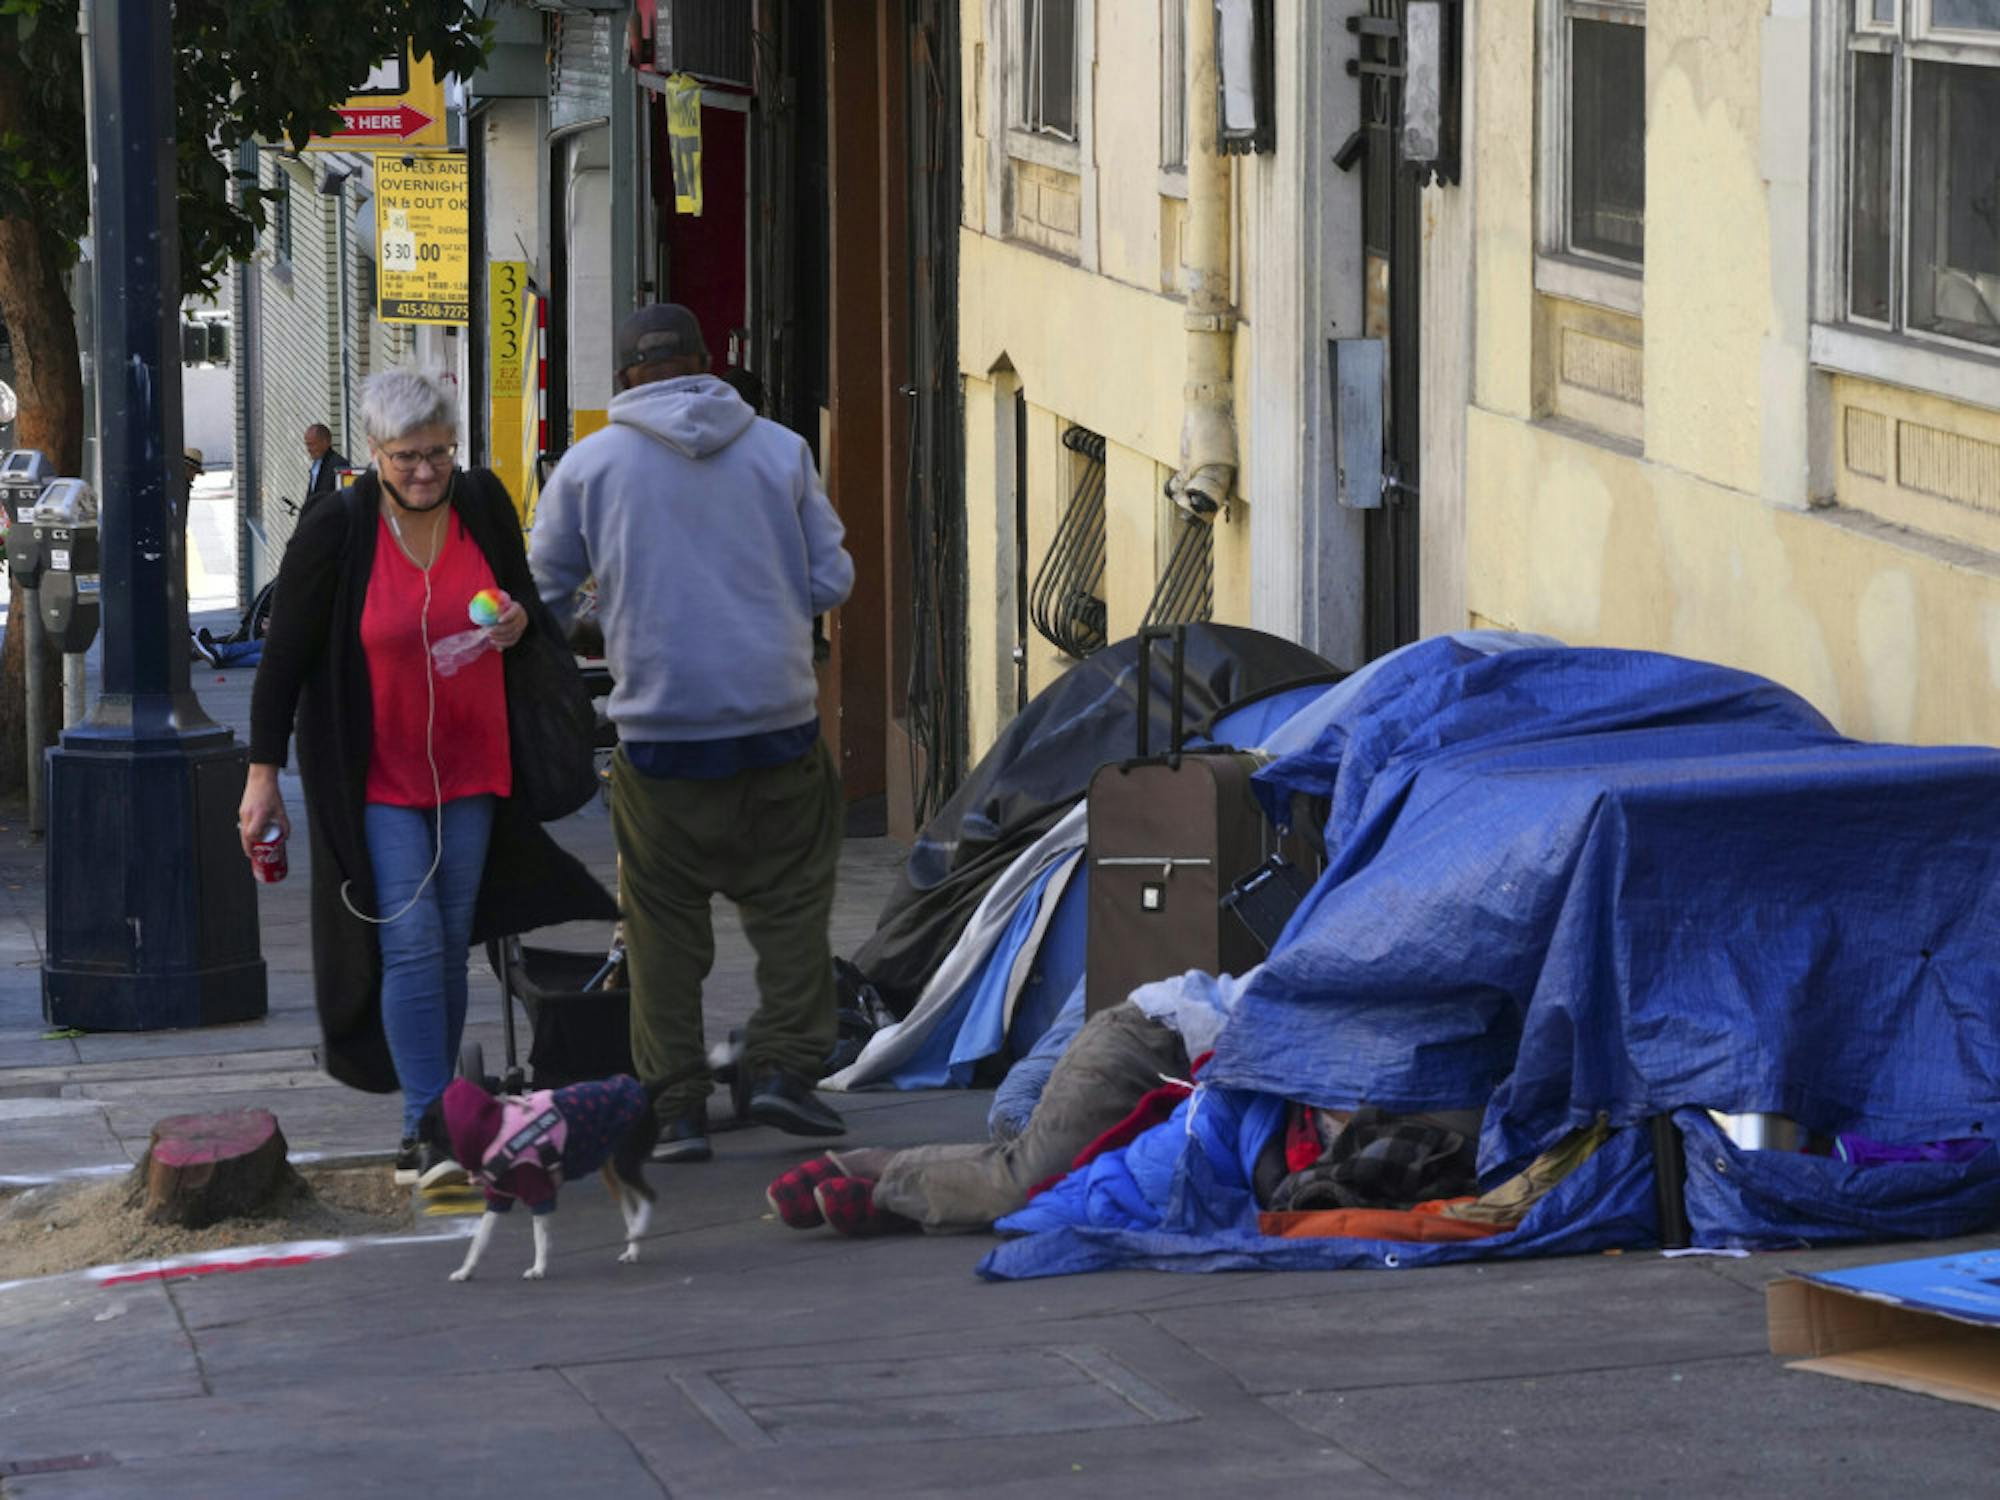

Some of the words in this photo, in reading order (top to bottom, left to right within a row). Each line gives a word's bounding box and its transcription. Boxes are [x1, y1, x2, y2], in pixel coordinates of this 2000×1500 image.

[358, 115, 402, 129] HERE
[439, 163, 467, 175] AND
[382, 196, 396, 208] IN
[415, 197, 444, 209] OUT
[448, 198, 468, 211] OK
